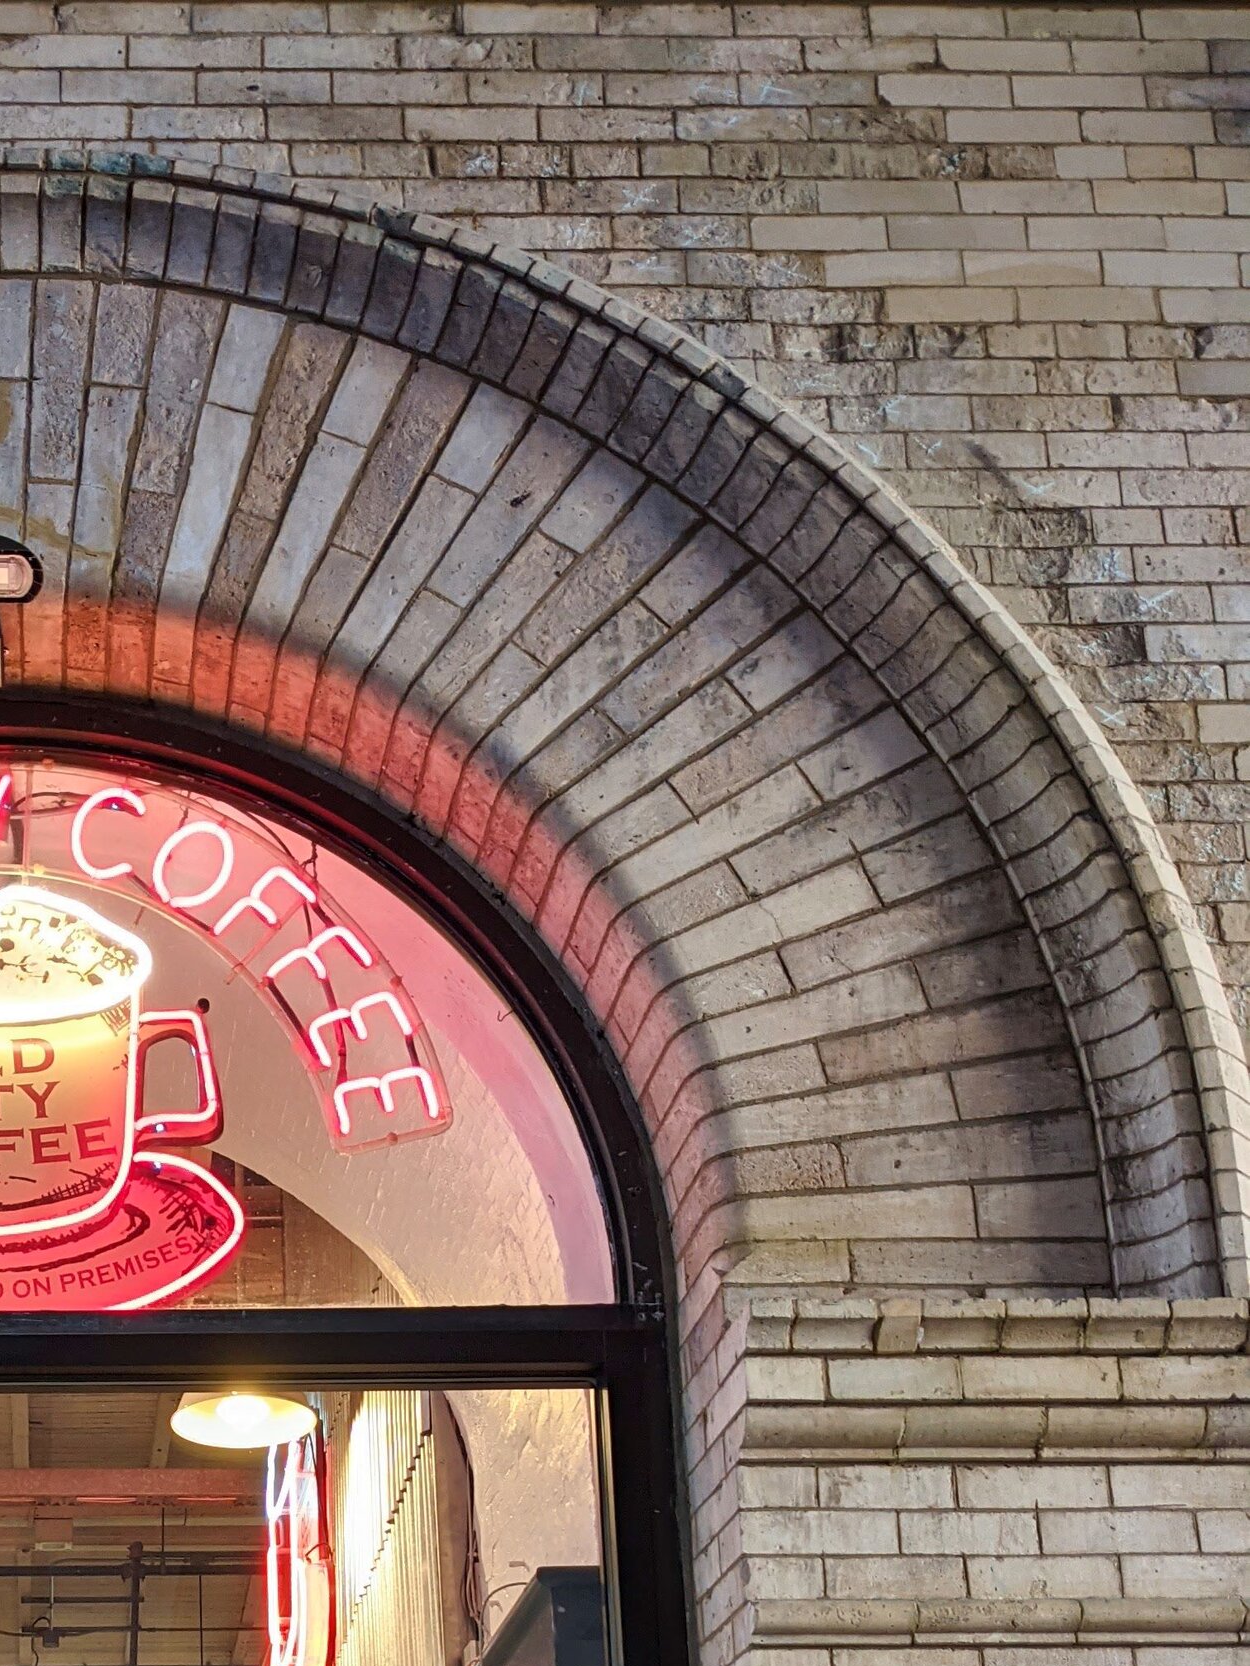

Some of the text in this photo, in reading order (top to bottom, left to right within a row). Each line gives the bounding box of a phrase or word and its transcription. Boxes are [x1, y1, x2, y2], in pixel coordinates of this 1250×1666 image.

[71, 787, 439, 1135] COFFEE
[12, 1276, 52, 1299] ON
[59, 1235, 195, 1293] PREMISES
